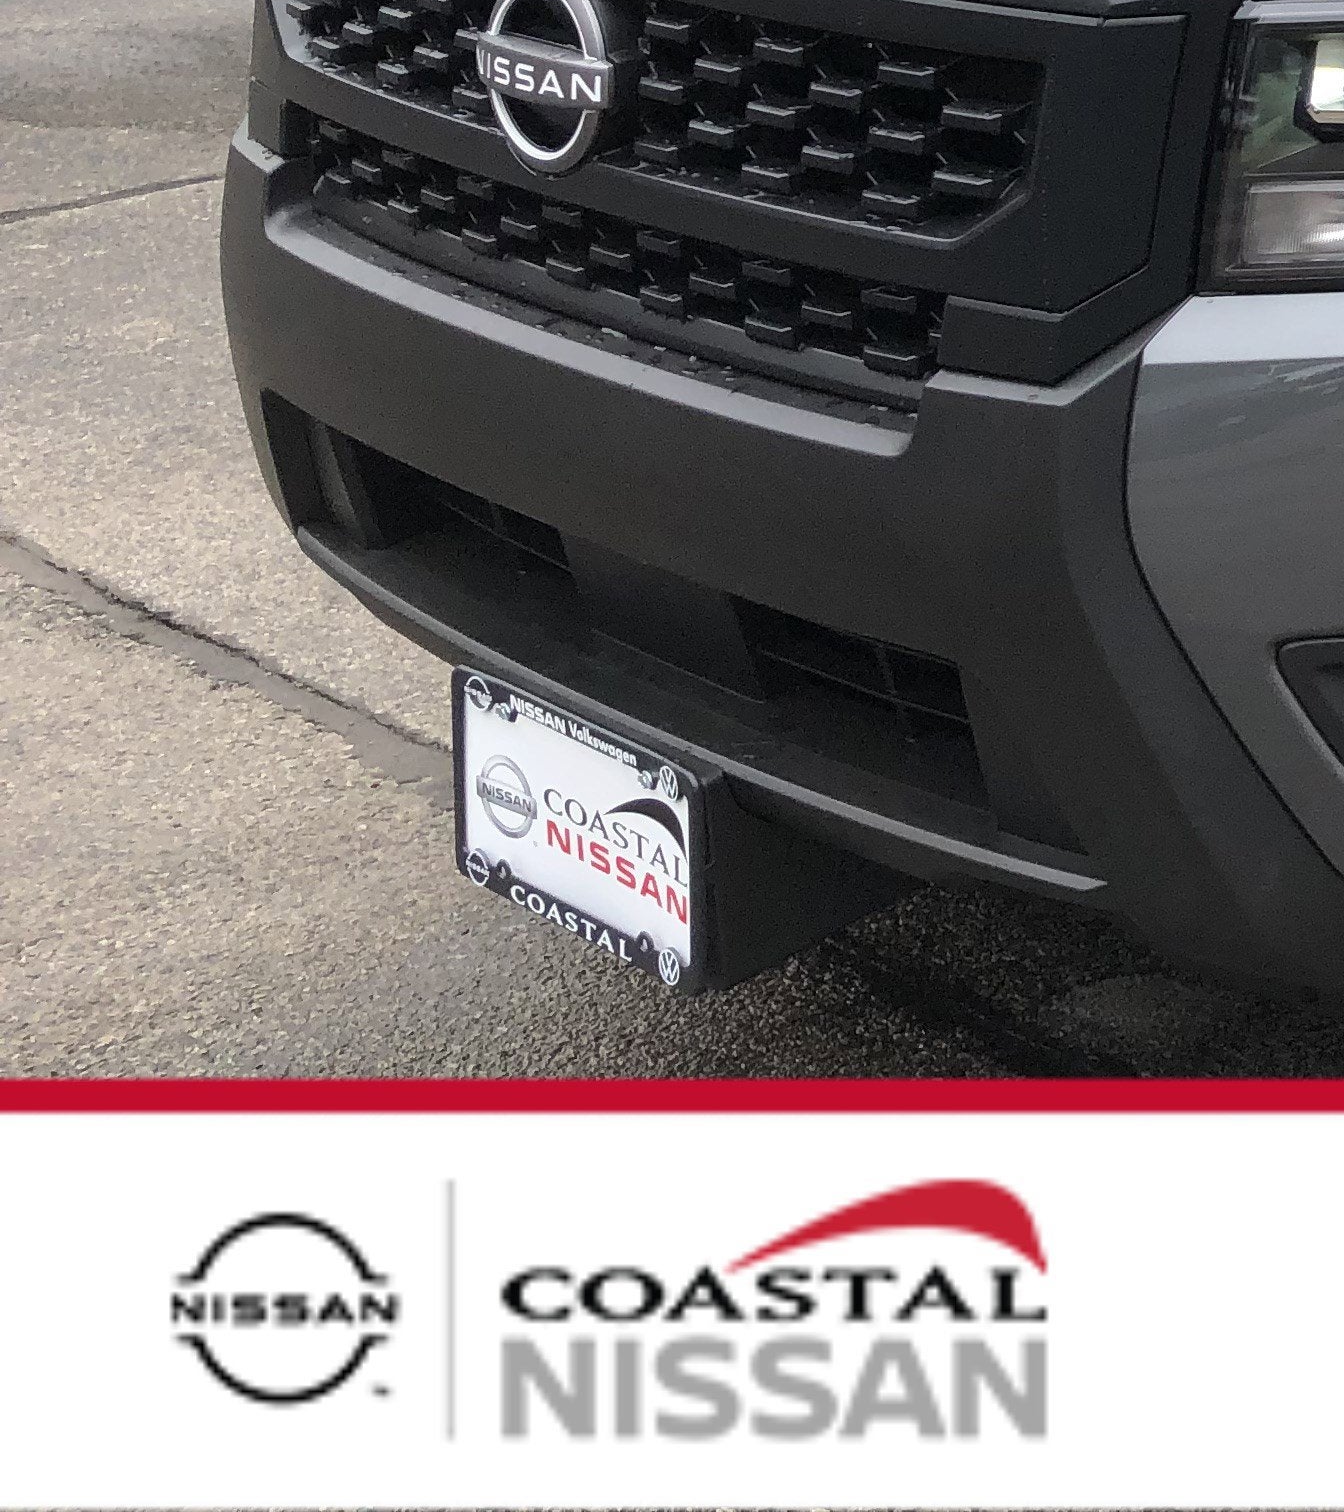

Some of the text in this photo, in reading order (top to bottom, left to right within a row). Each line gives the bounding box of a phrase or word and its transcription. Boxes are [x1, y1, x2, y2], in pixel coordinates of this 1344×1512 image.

[475, 44, 602, 103] NISSAN
[509, 693, 638, 767] NISSAN Volkswagen
[482, 781, 533, 813] NISSAN
[543, 788, 688, 888] COASTAL
[546, 819, 688, 925] NISSAN
[510, 884, 633, 963] COASTAL
